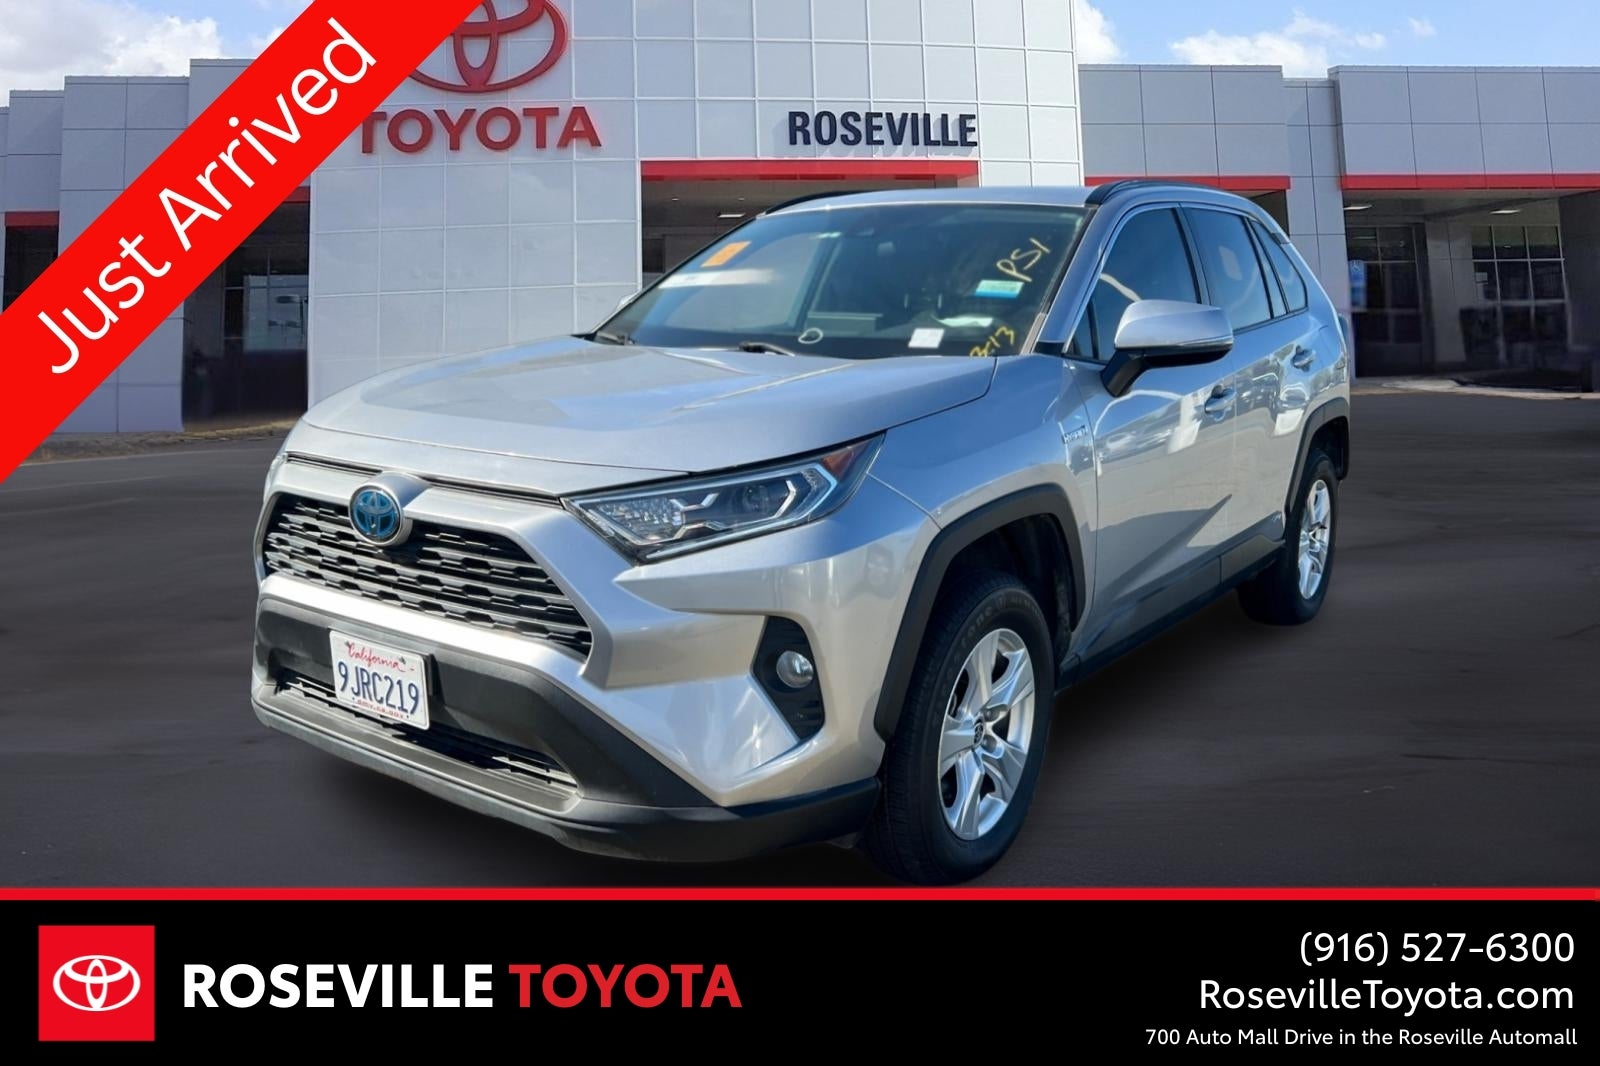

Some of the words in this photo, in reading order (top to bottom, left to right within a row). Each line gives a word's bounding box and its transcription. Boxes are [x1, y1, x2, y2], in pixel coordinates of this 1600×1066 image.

[361, 106, 602, 153] TOYOTA
[789, 111, 978, 147] ROSEVILLE
[346, 642, 406, 673] California
[338, 661, 419, 714] 9JRC219
